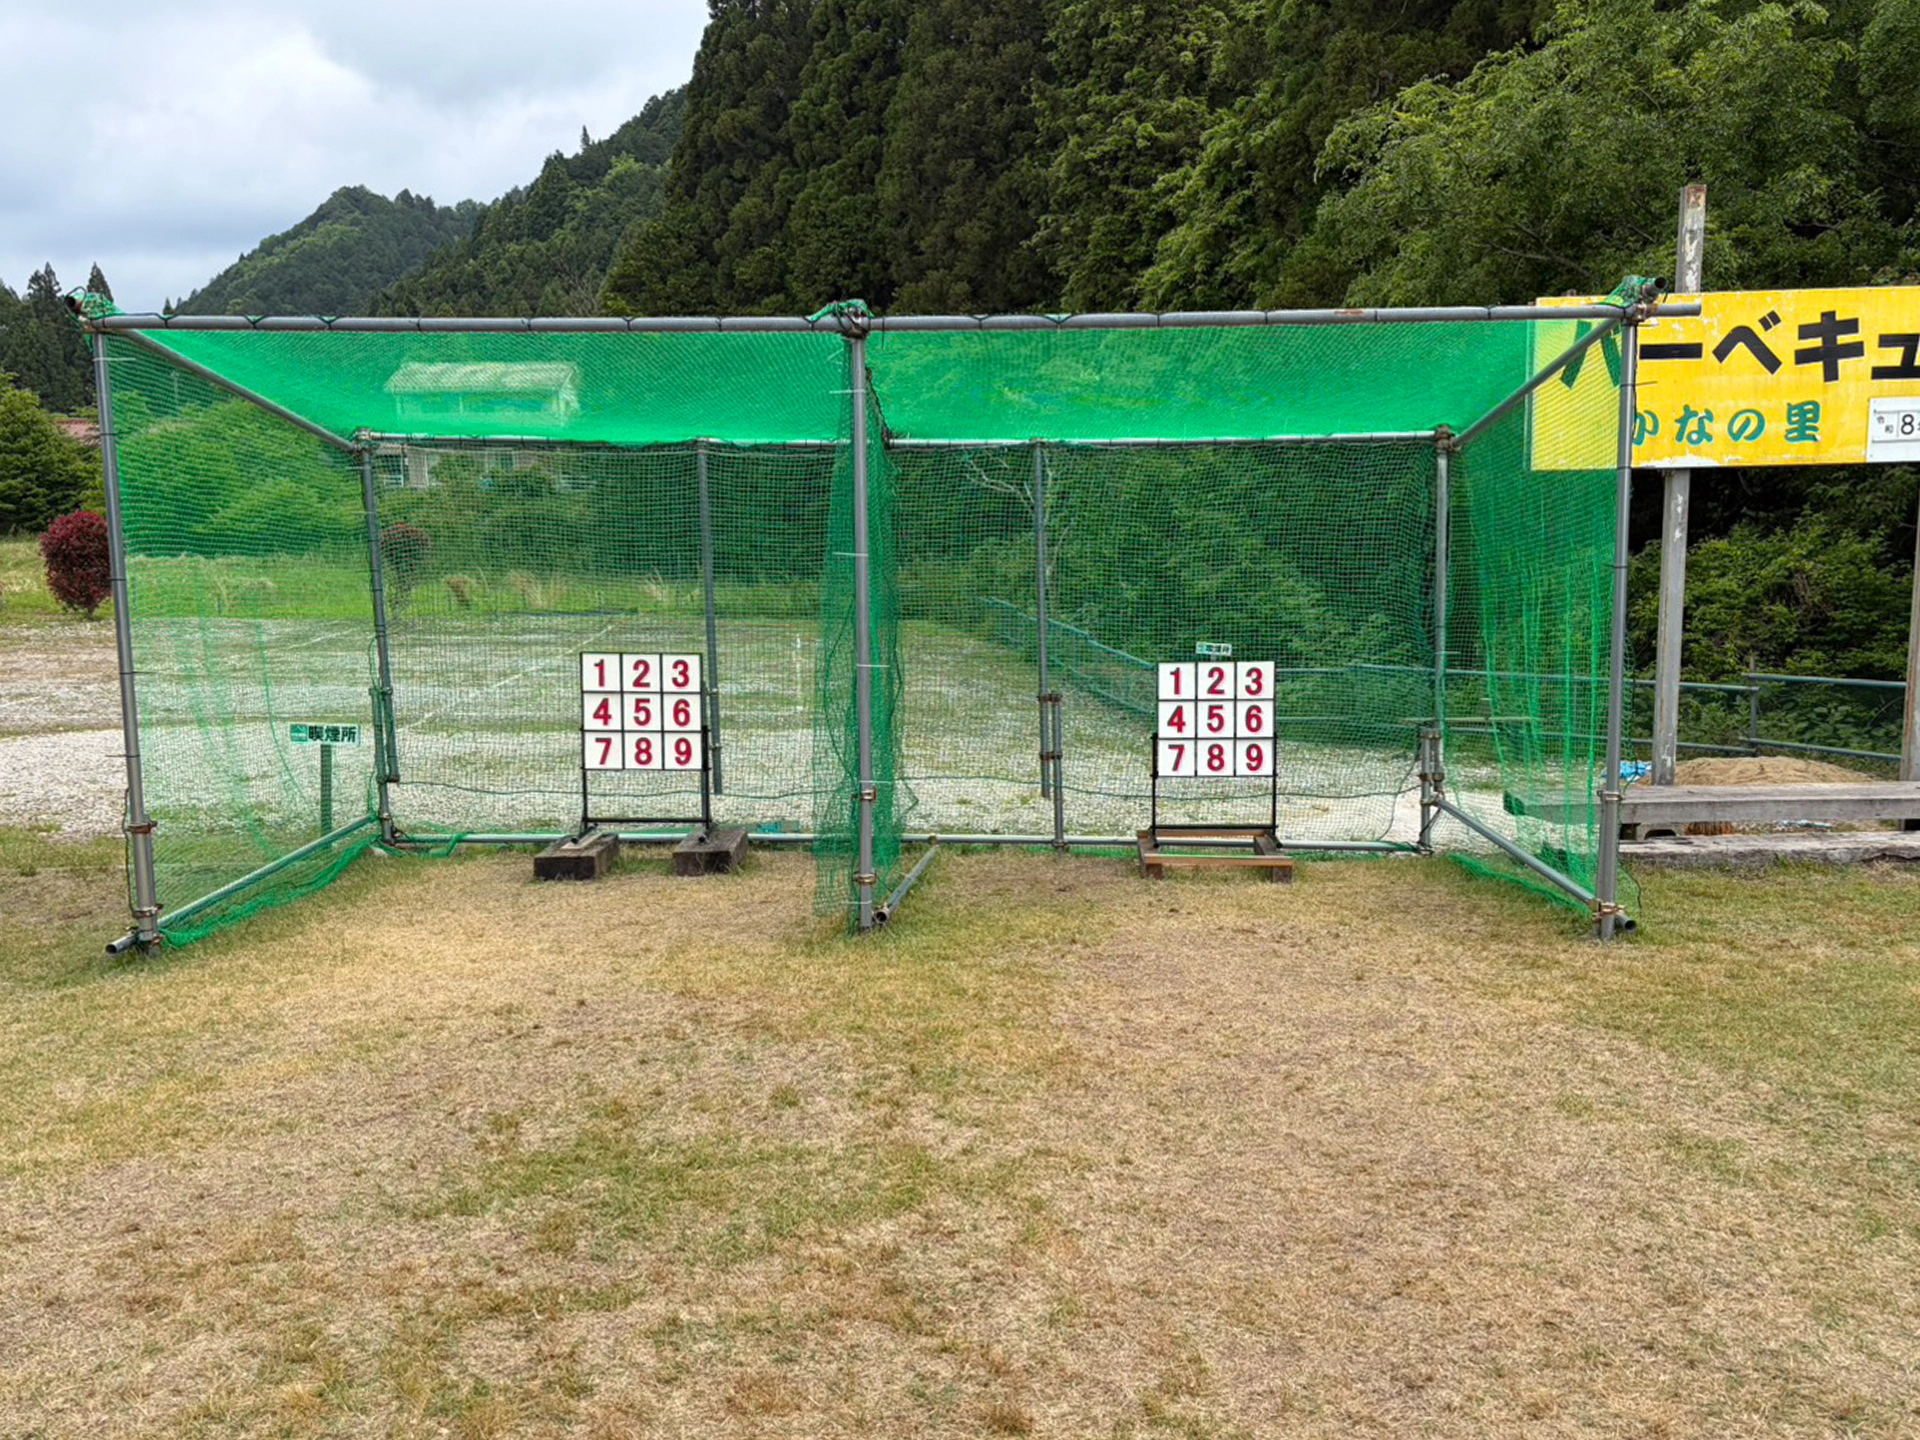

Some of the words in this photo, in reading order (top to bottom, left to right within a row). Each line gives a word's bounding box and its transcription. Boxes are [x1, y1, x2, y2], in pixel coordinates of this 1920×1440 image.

[594, 659, 605, 687] 1
[632, 660, 651, 688] 2
[671, 660, 690, 688] 3
[1169, 667, 1181, 695] 1
[1207, 667, 1225, 695] 2
[1245, 667, 1263, 695] 3
[592, 698, 612, 726] 4
[634, 698, 651, 726] 5
[673, 699, 690, 727] 6
[1167, 705, 1186, 733] 4
[1207, 704, 1225, 733] 5
[1245, 704, 1263, 733] 6
[309, 725, 356, 742] 喫煙所
[595, 737, 612, 765] 7
[634, 737, 652, 765] 8
[675, 738, 692, 766] 9
[1168, 744, 1185, 772] 7
[1207, 743, 1225, 771] 8
[1246, 743, 1263, 772] 9
